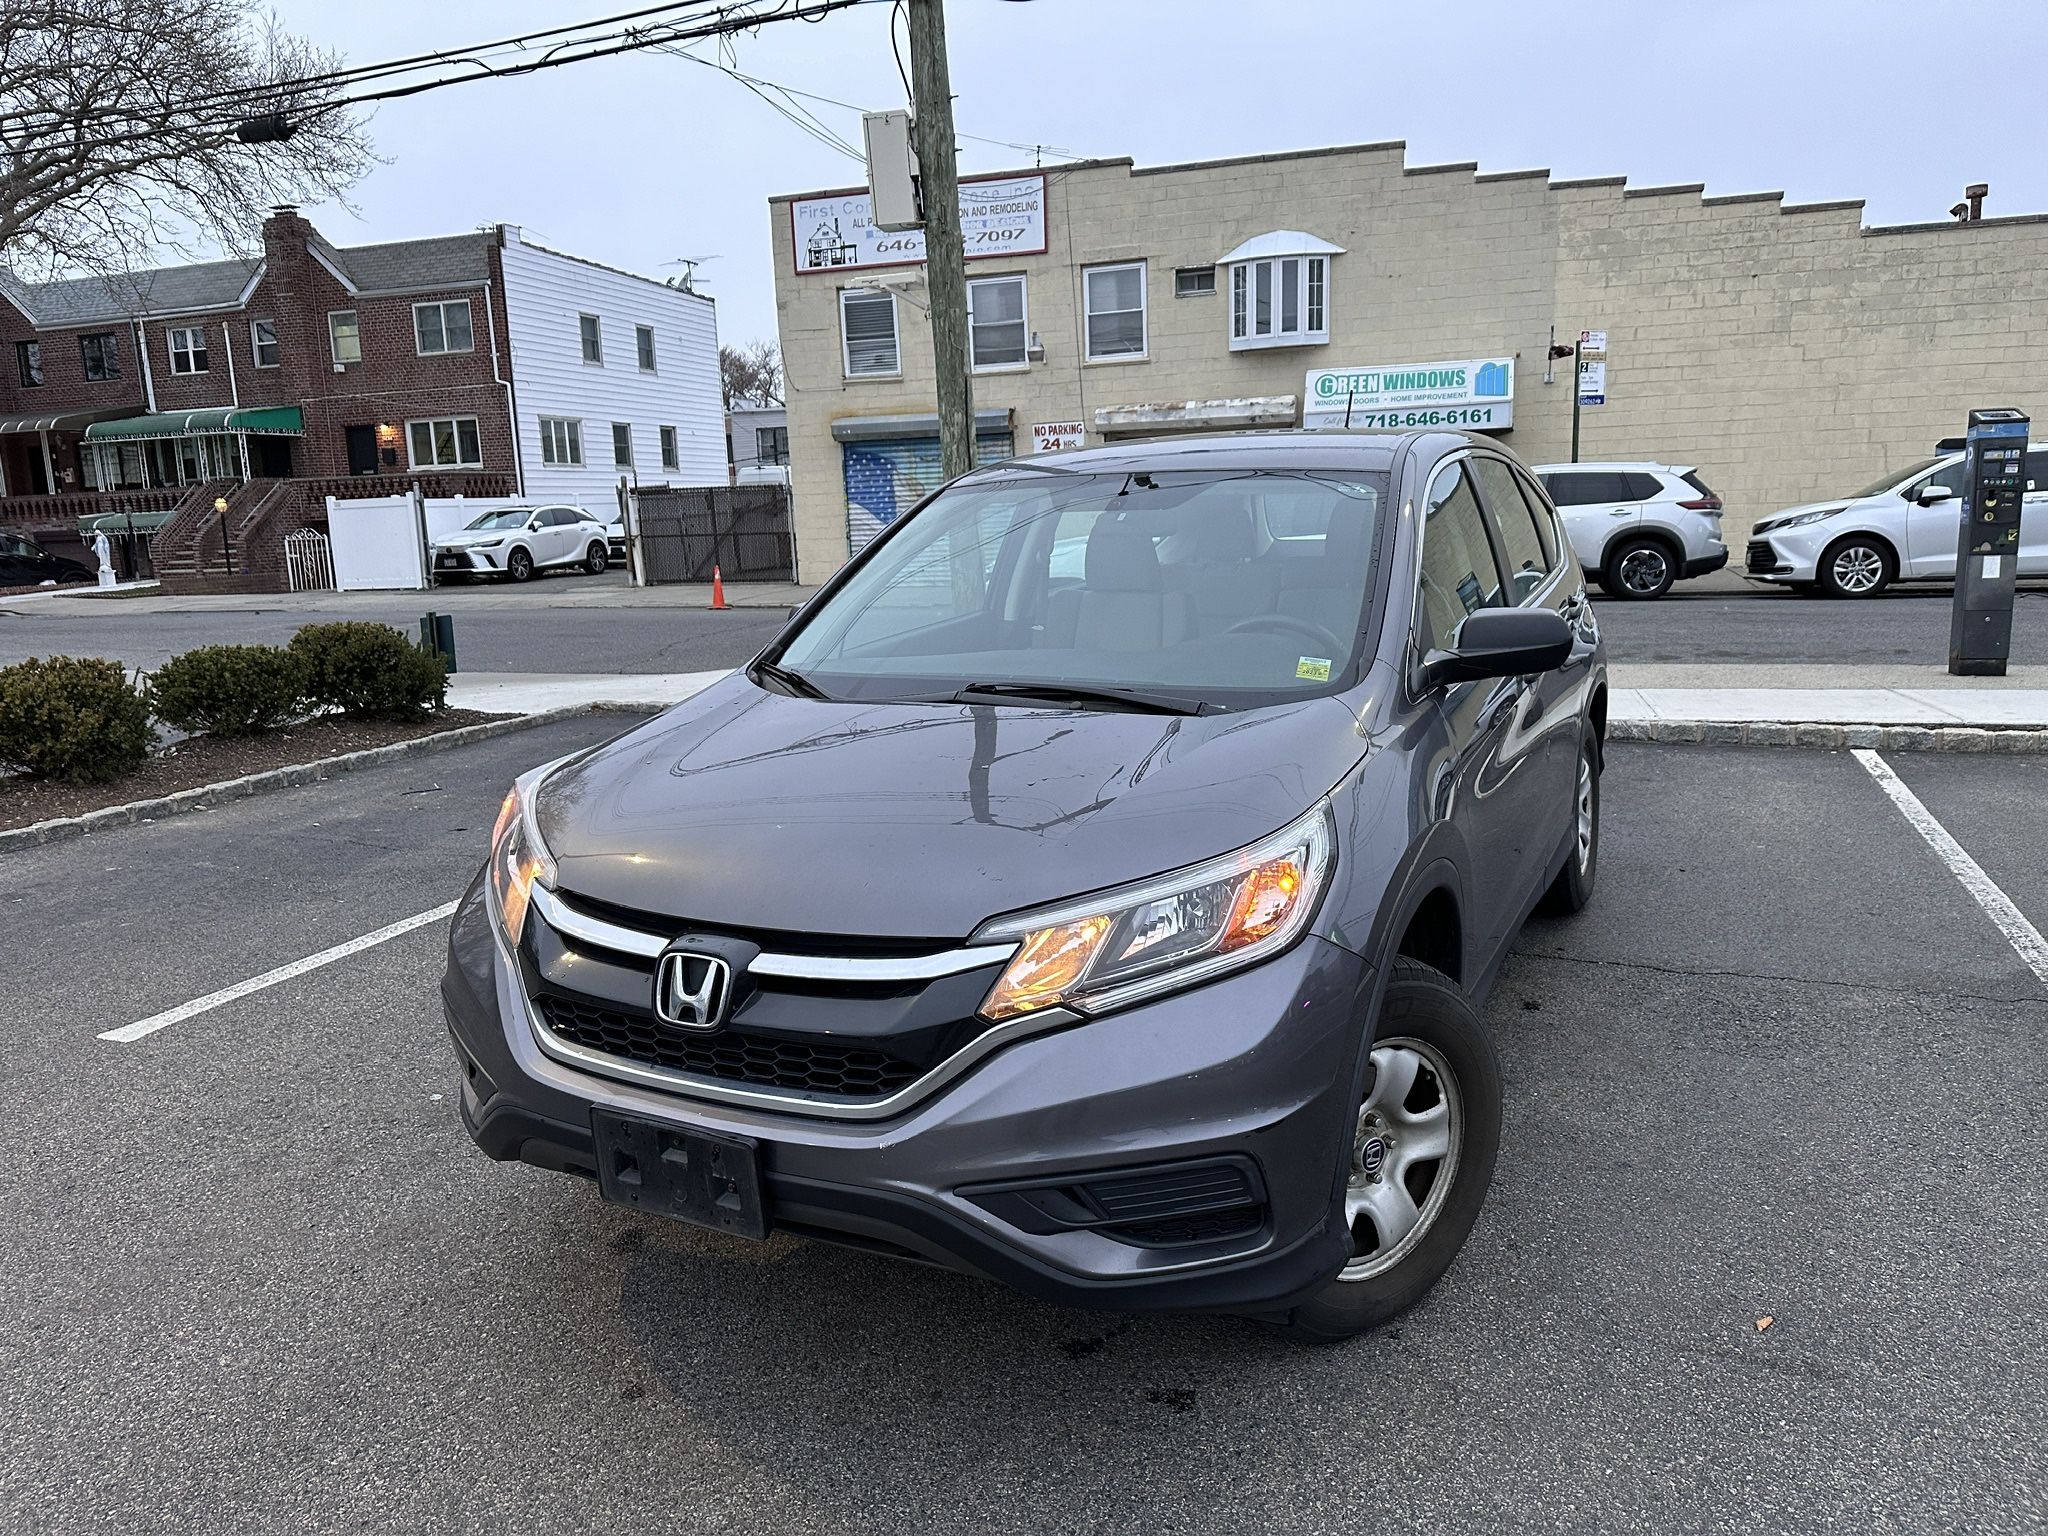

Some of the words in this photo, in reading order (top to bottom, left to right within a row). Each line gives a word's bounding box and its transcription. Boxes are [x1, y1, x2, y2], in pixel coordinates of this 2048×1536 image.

[799, 204, 835, 219] First
[852, 218, 865, 229] ALL
[971, 205, 988, 217] AND
[989, 200, 1039, 215] REMODELING
[1581, 362, 1587, 372] 2
[1315, 373, 1380, 398] GREEN
[1383, 369, 1466, 391] WINDOWS
[1353, 396, 1380, 405] DOORS
[1390, 394, 1414, 403] HOME
[1413, 391, 1468, 401] IMPROVEMENT
[1365, 407, 1492, 428] 718-646-6161
[1034, 425, 1047, 437] NO
[1048, 423, 1083, 435] PARKING
[1041, 437, 1061, 450] 24
[1966, 446, 1974, 469] P
